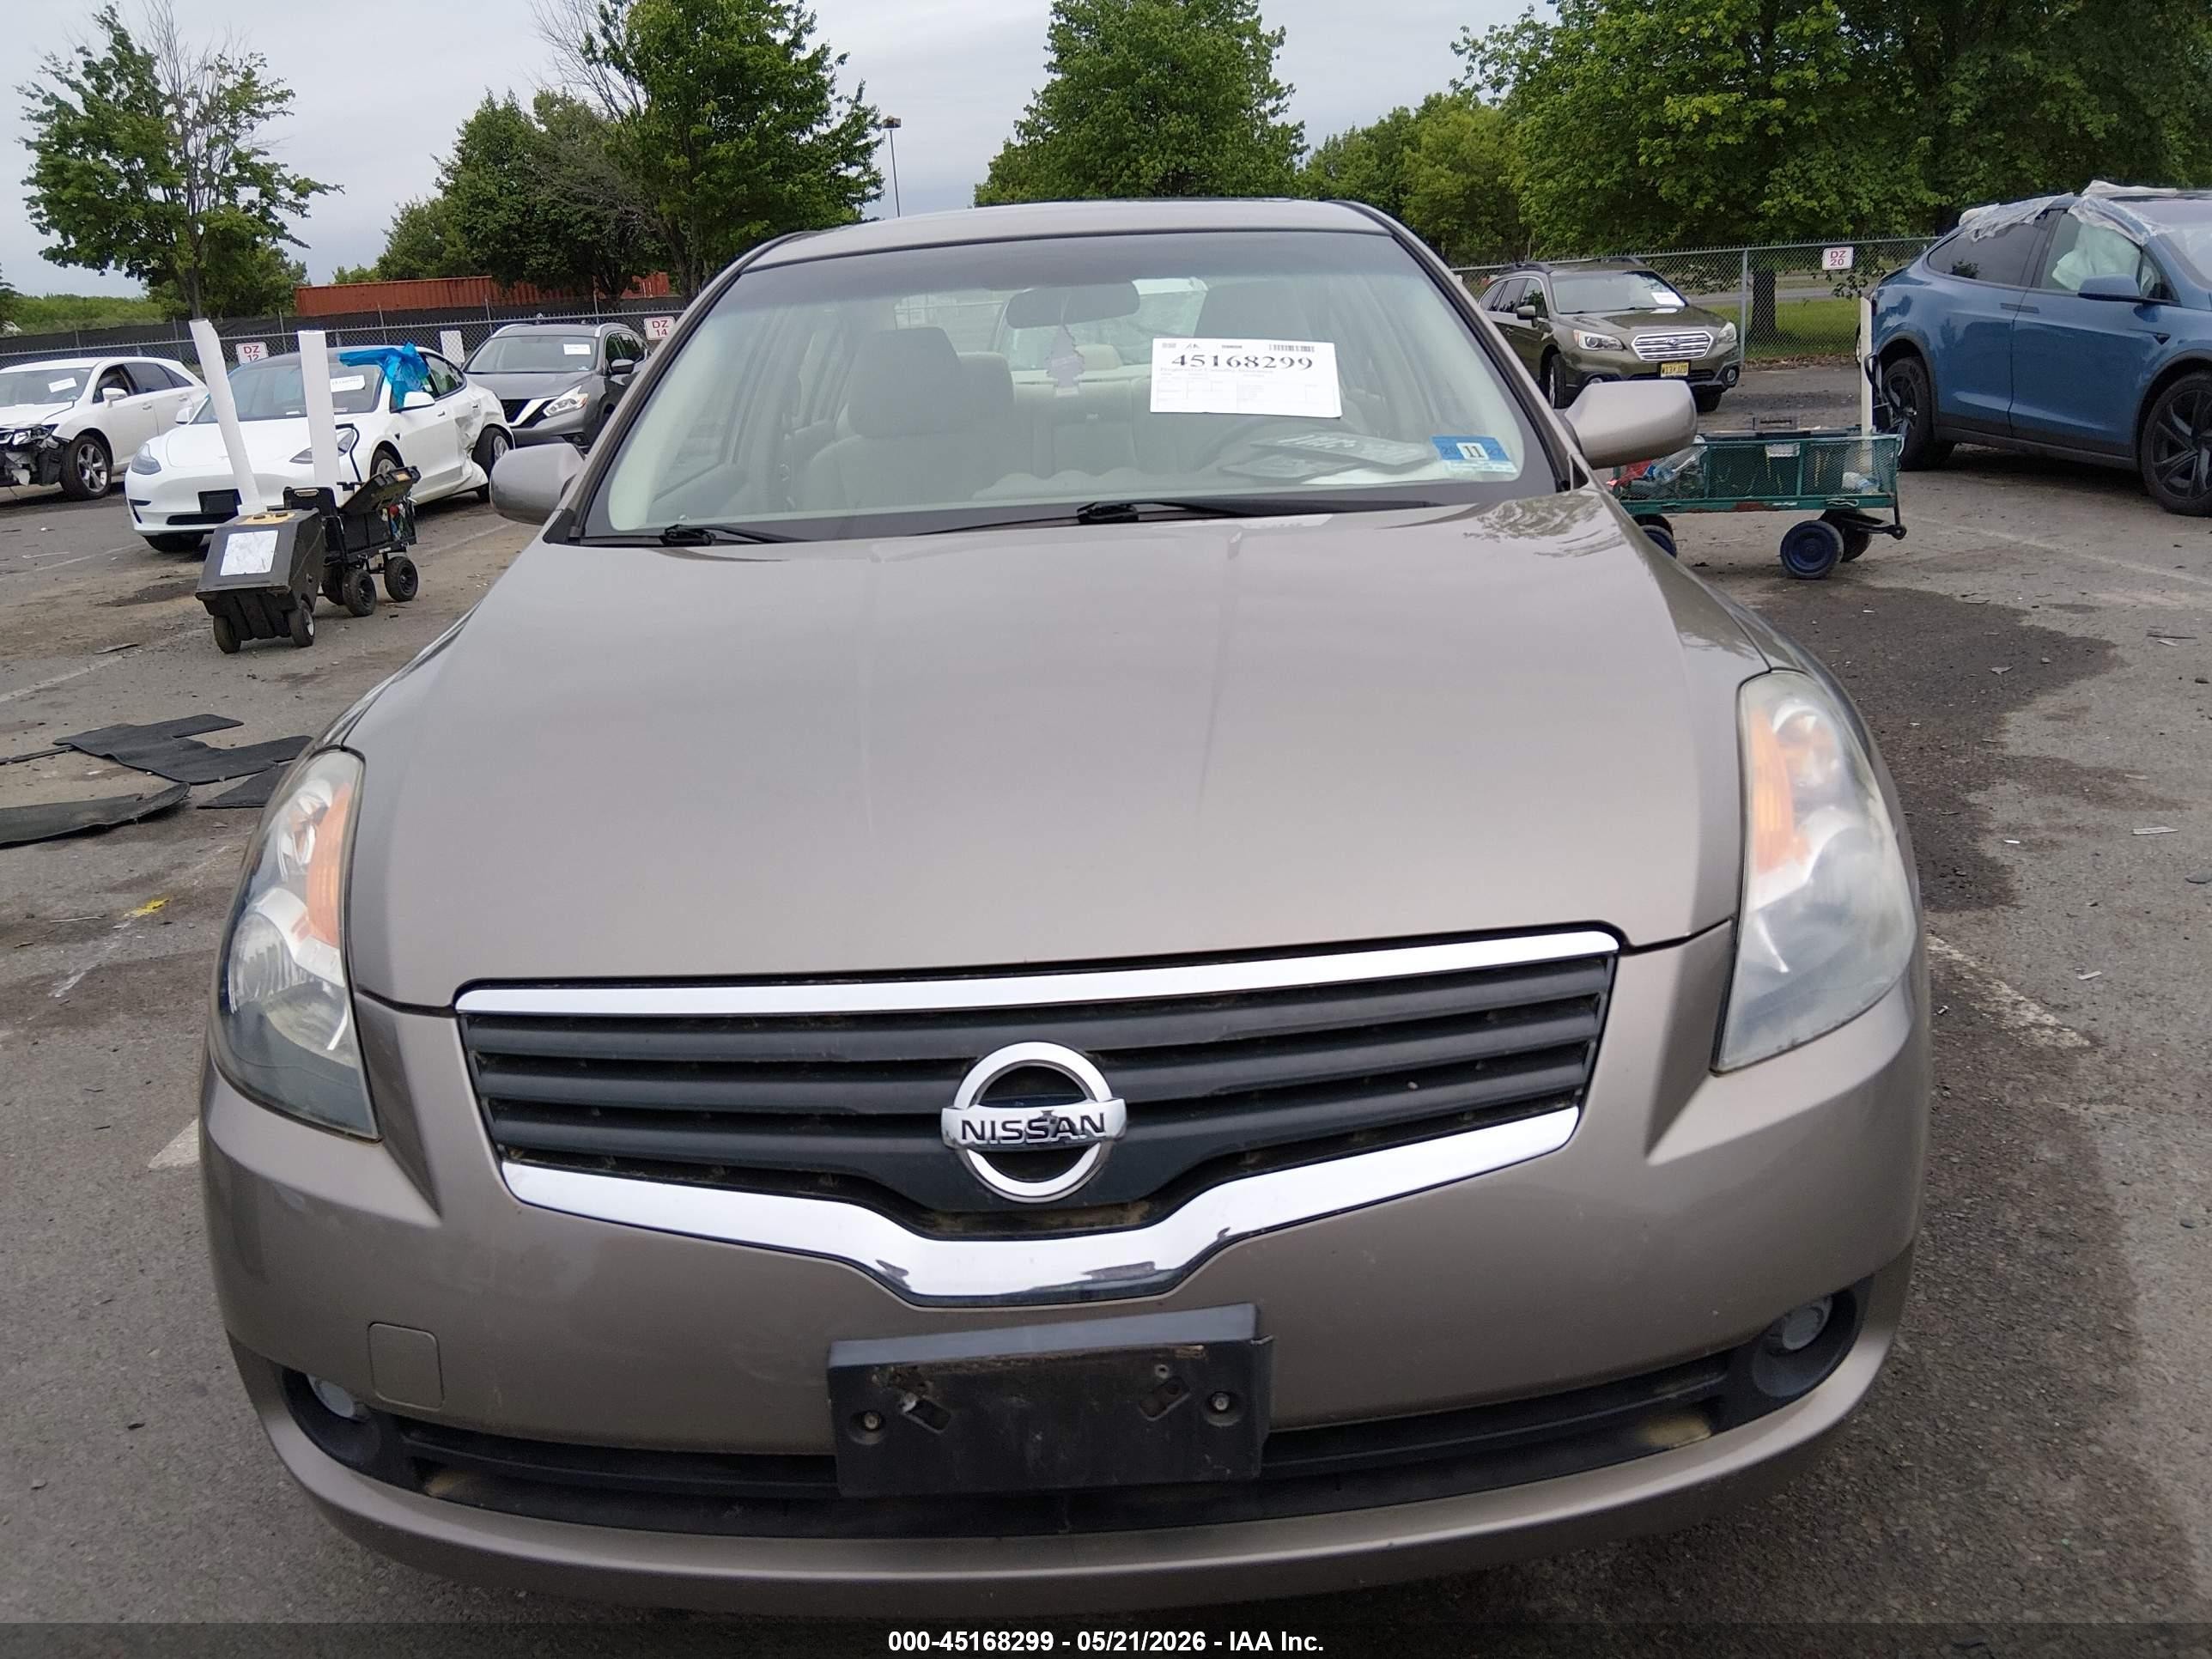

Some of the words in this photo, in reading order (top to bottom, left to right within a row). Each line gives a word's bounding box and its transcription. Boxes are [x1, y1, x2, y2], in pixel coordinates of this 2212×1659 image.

[652, 319, 668, 328] DZ
[243, 345, 259, 354] DZ
[1171, 354, 1313, 370] 45168299
[1463, 446, 1485, 458] 11
[960, 1112, 1106, 1142] NISSAN
